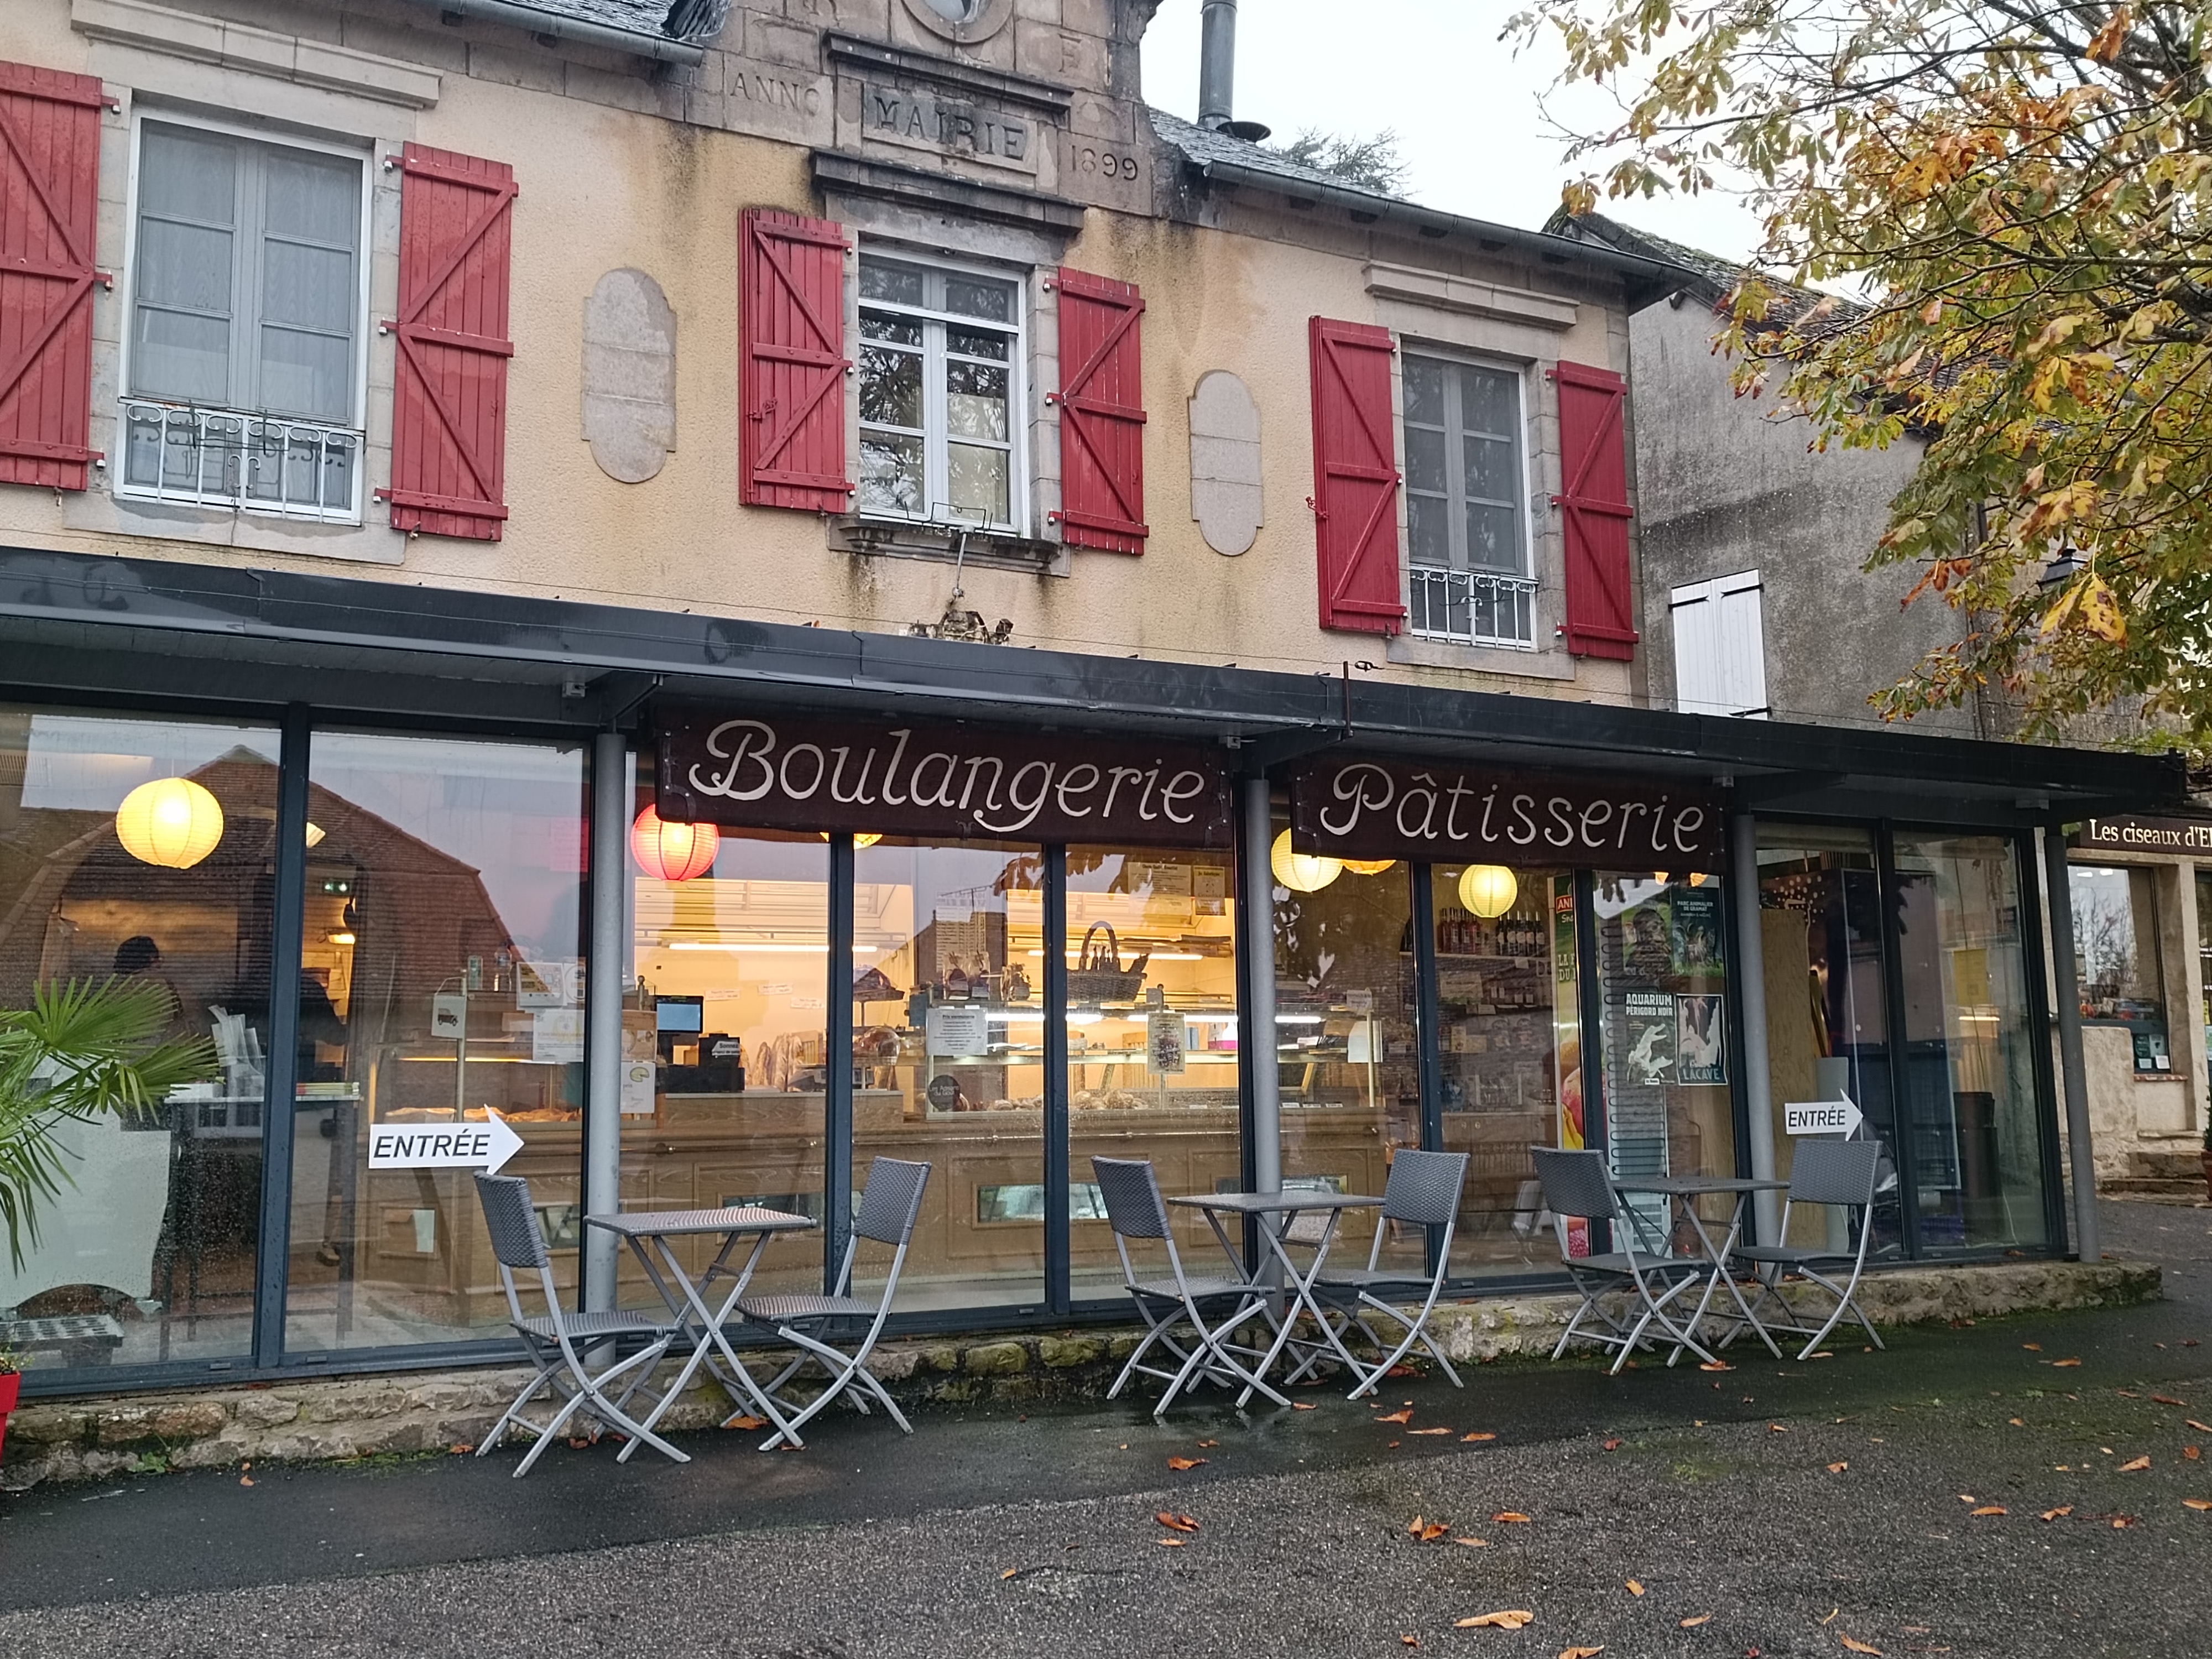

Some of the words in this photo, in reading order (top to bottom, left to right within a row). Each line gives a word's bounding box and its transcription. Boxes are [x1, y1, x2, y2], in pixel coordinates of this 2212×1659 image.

[731, 72, 820, 115] ANNO
[873, 95, 1025, 161] MAIRIE
[1071, 144, 1139, 182] 1899
[688, 719, 1204, 832] Boulangerie
[1319, 763, 1704, 853] Pâtisserie
[2089, 818, 2119, 842] Les
[2122, 821, 2181, 846] ciseaux
[1558, 897, 1573, 910] AN
[1558, 954, 1568, 967] LA
[1558, 968, 1570, 981] DU
[1626, 993, 1672, 1005] AQUARIUM
[1626, 1005, 1657, 1016] PÉRIGORD
[1658, 1007, 1673, 1016] NOIR
[1683, 1068, 1720, 1080] LACAVE
[1788, 1105, 1846, 1128] ENTRÉE
[373, 1129, 491, 1159] ENTRÉE
